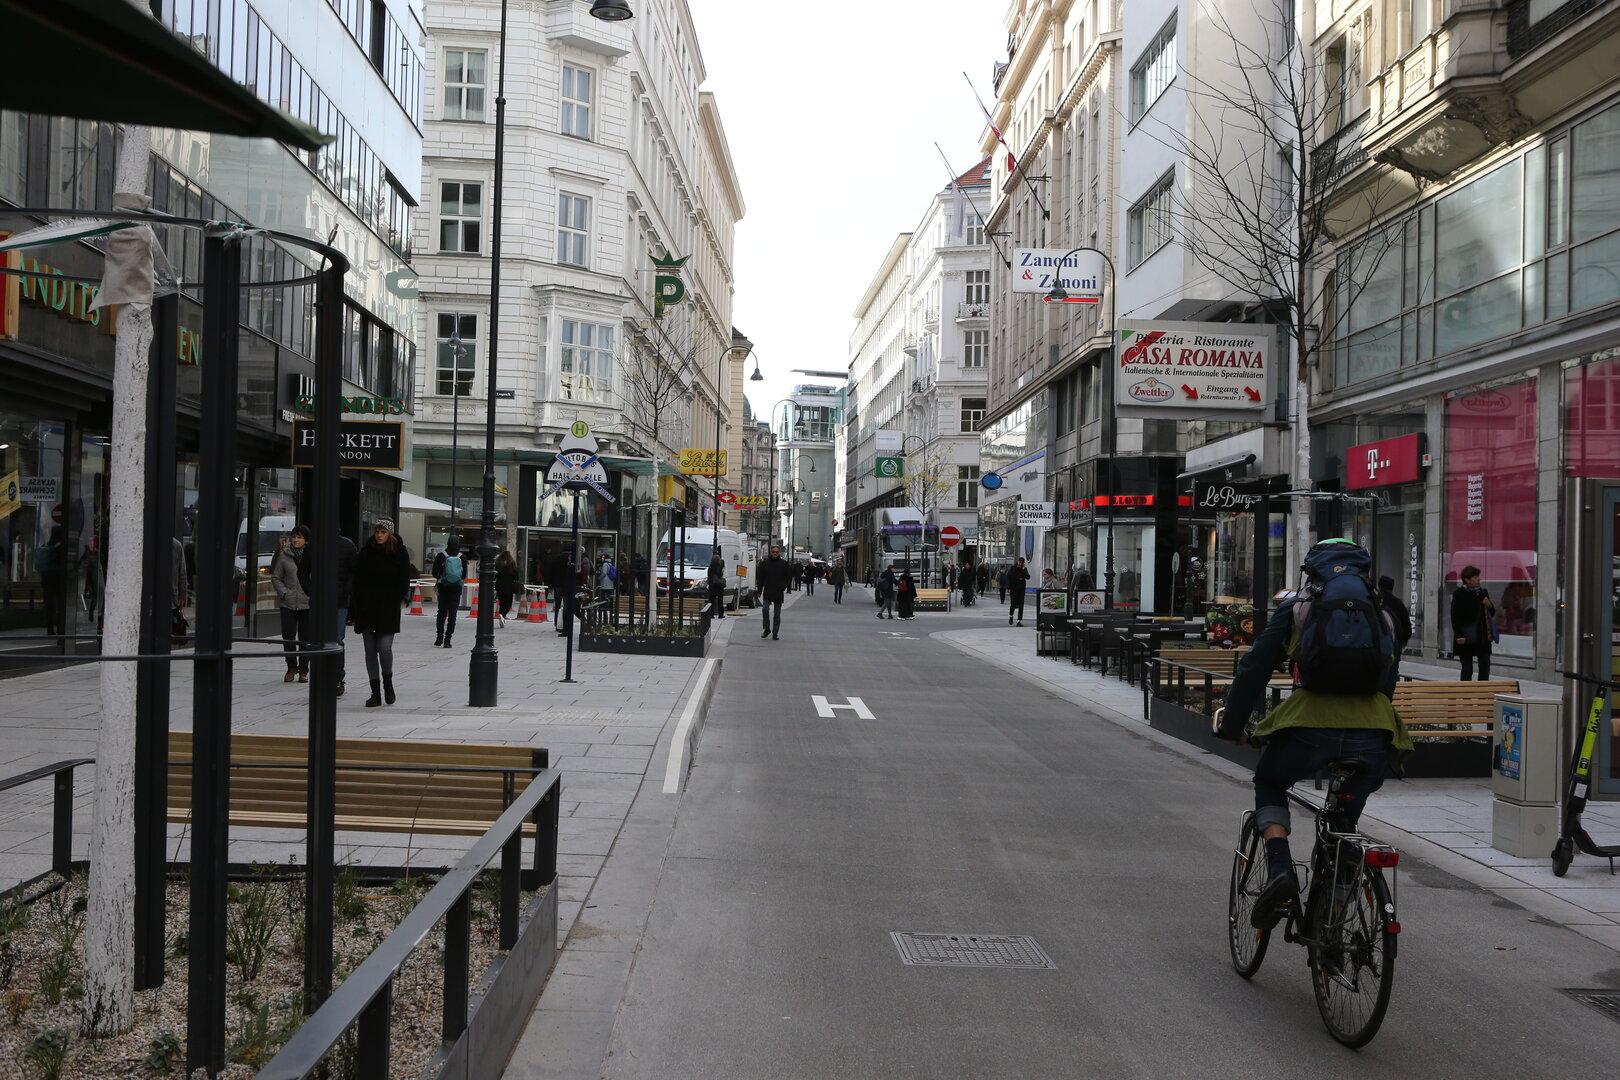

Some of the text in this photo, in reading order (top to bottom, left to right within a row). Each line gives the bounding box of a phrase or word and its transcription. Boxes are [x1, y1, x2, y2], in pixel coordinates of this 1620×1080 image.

[1020, 252, 1078, 267] Zanoni
[1022, 269, 1096, 289] & Znoni
[655, 275, 685, 319] P
[1136, 333, 1184, 345] Pizzeria
[1194, 335, 1254, 348] Ristorante
[1123, 346, 1263, 368] CASA ROMANA
[1124, 366, 1163, 375] Italienische
[1172, 368, 1219, 377] Internationale
[1221, 369, 1264, 379] Spezialitäten
[1134, 386, 1169, 397] Zwettler
[1206, 385, 1239, 394] Eingang
[576, 424, 585, 435] H
[301, 430, 396, 448] HKETT
[1019, 503, 1044, 511] ALYSSA
